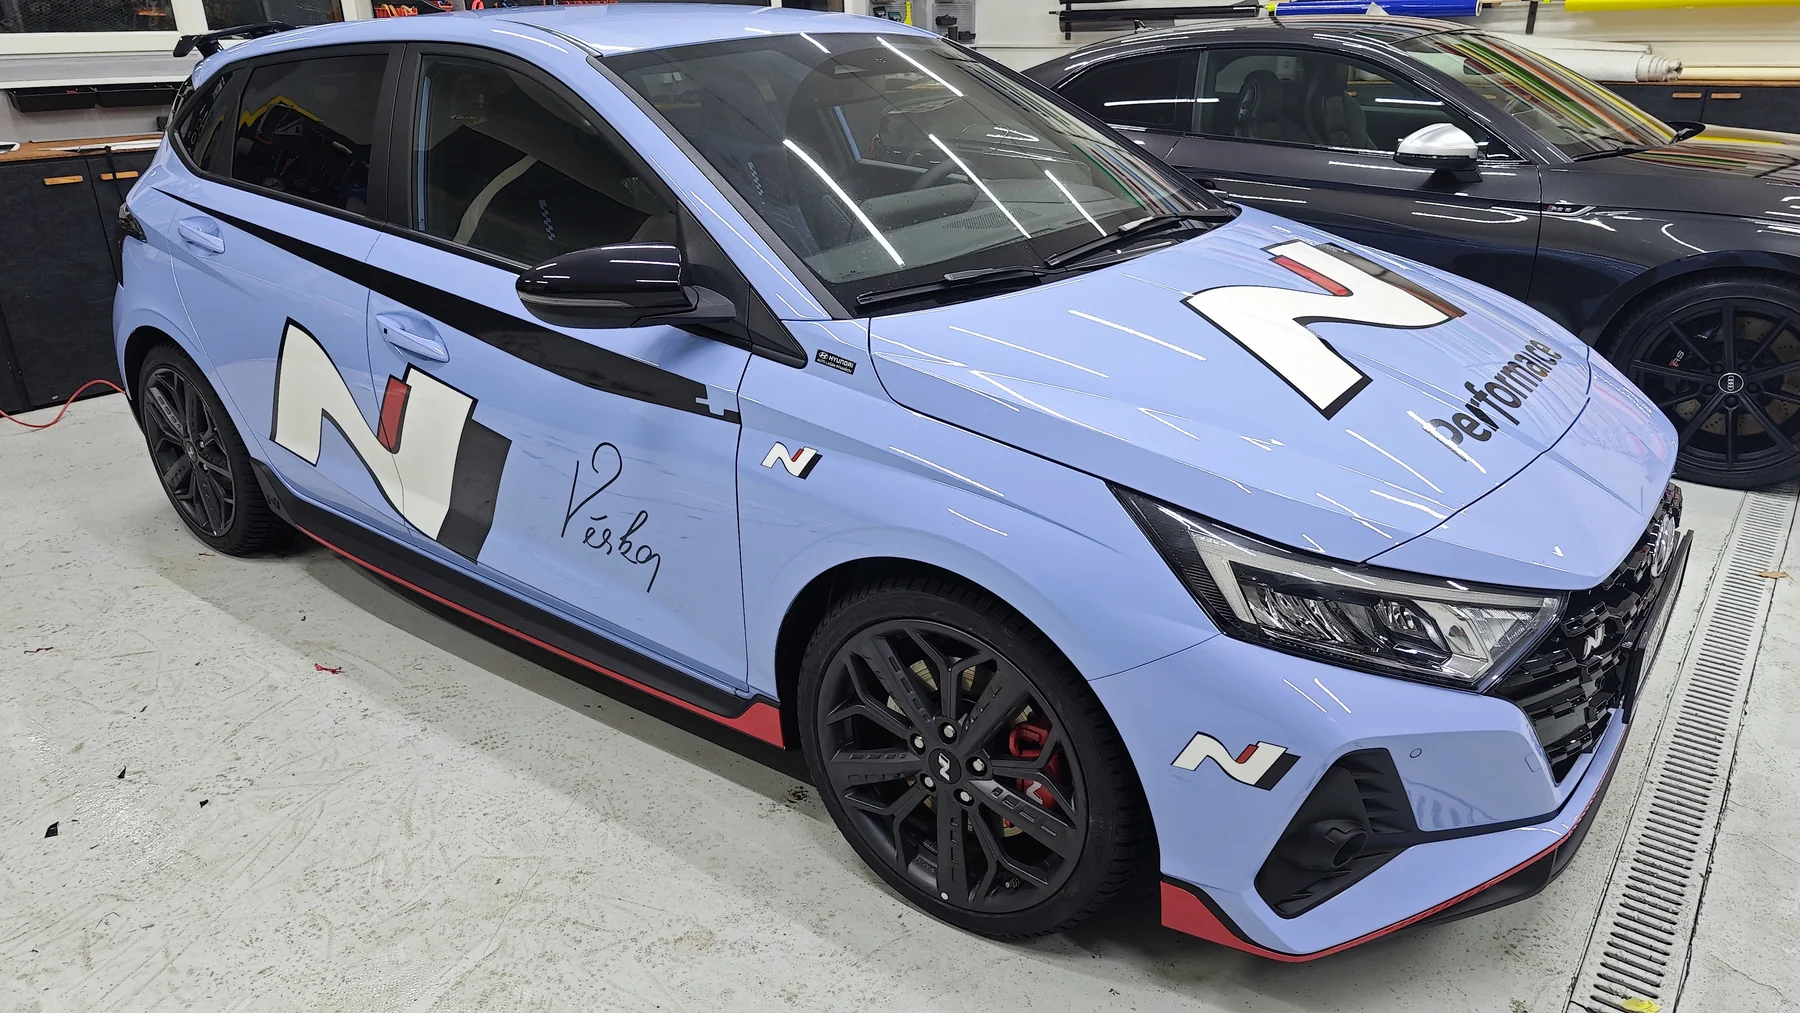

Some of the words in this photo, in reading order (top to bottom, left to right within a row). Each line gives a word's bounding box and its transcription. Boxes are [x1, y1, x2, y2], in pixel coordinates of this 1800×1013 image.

[1179, 239, 1467, 421] N
[829, 355, 853, 368] HYUNDAI
[1669, 350, 1685, 367] RS
[270, 317, 512, 564] N
[760, 441, 823, 480] N
[1171, 731, 1301, 791] N
